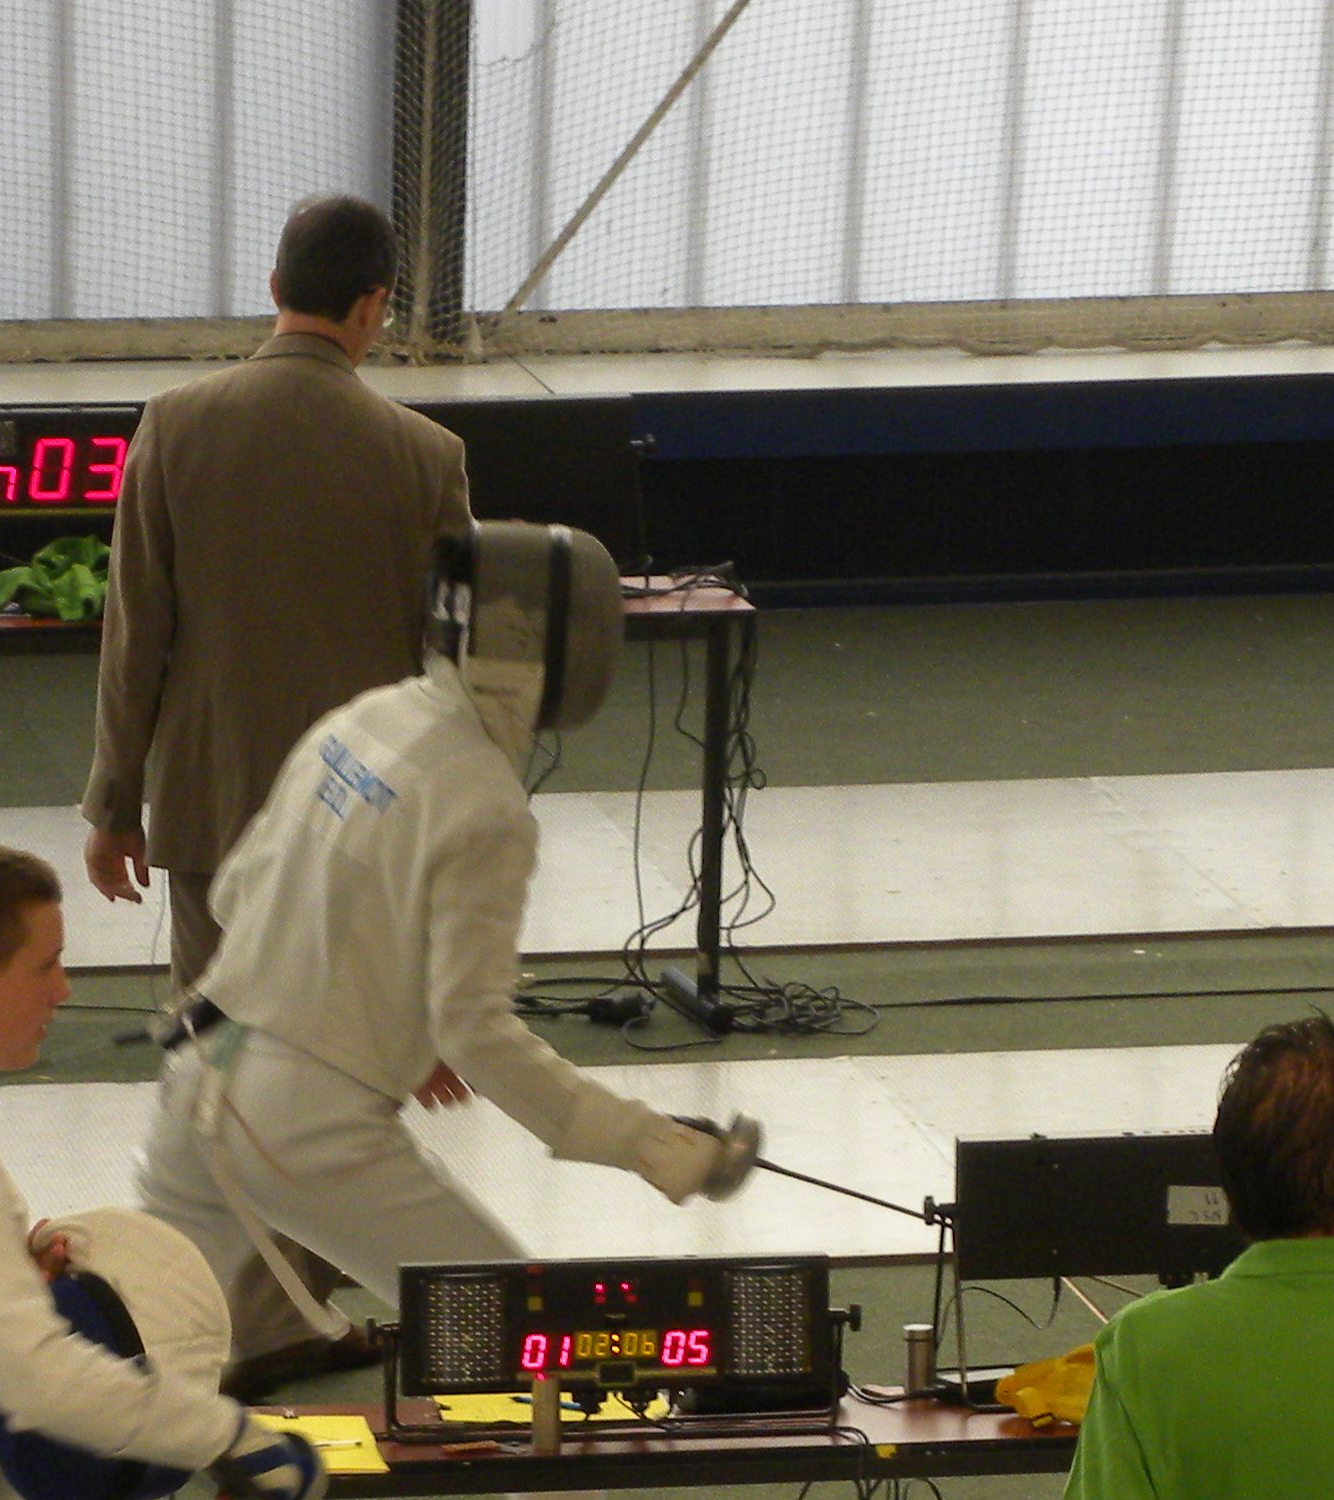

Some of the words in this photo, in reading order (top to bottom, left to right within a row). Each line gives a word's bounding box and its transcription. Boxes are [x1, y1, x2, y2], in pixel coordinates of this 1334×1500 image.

[28, 437, 128, 501] 03
[521, 1333, 572, 1369] 01
[661, 1329, 710, 1365] 05
